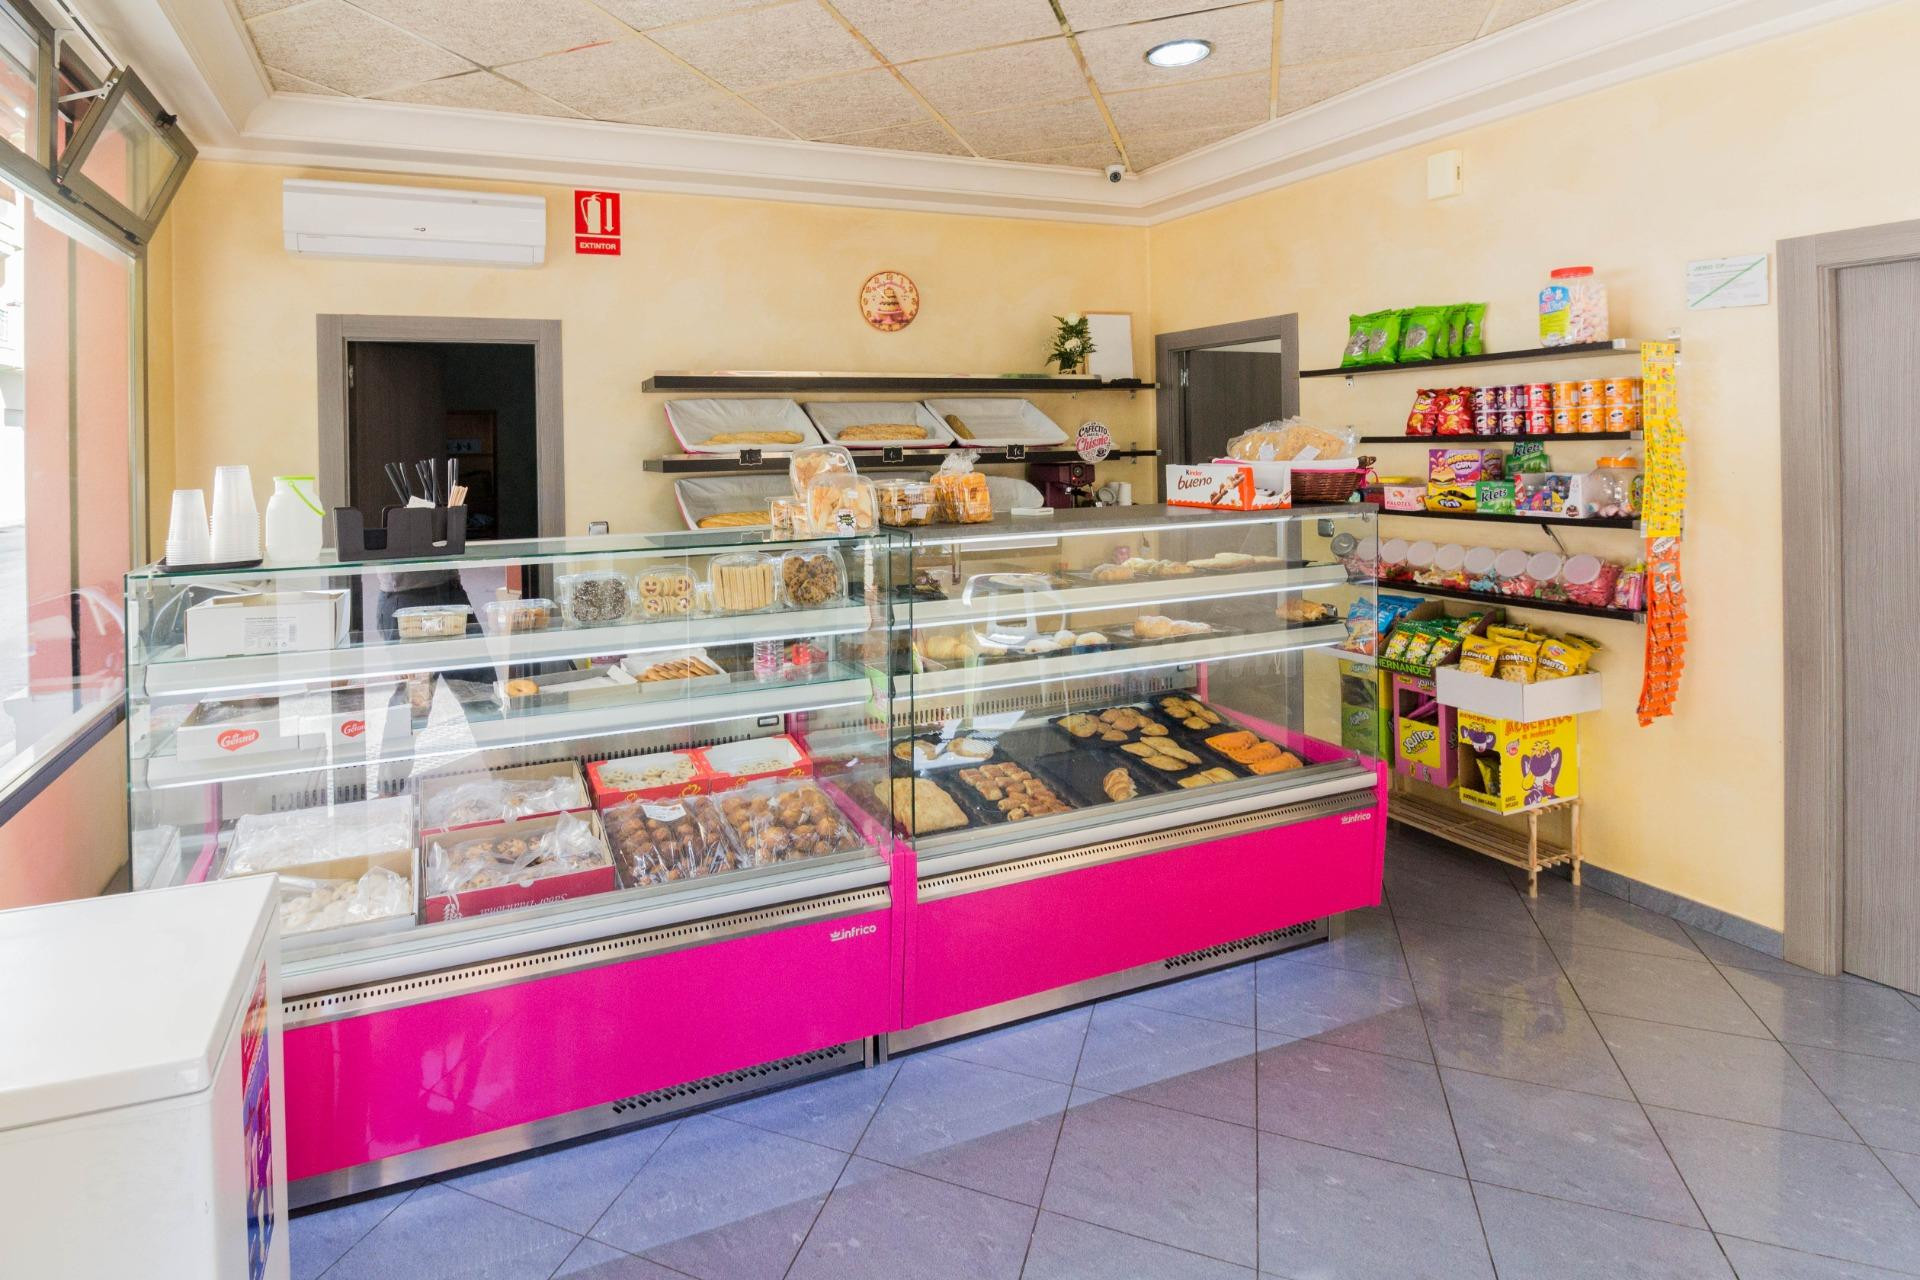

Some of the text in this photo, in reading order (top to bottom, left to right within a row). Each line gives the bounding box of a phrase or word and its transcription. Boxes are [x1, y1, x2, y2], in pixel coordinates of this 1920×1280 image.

[580, 242, 616, 250] EXTINTOR
[1177, 476, 1213, 490] bueno
[842, 924, 877, 940] infrico
